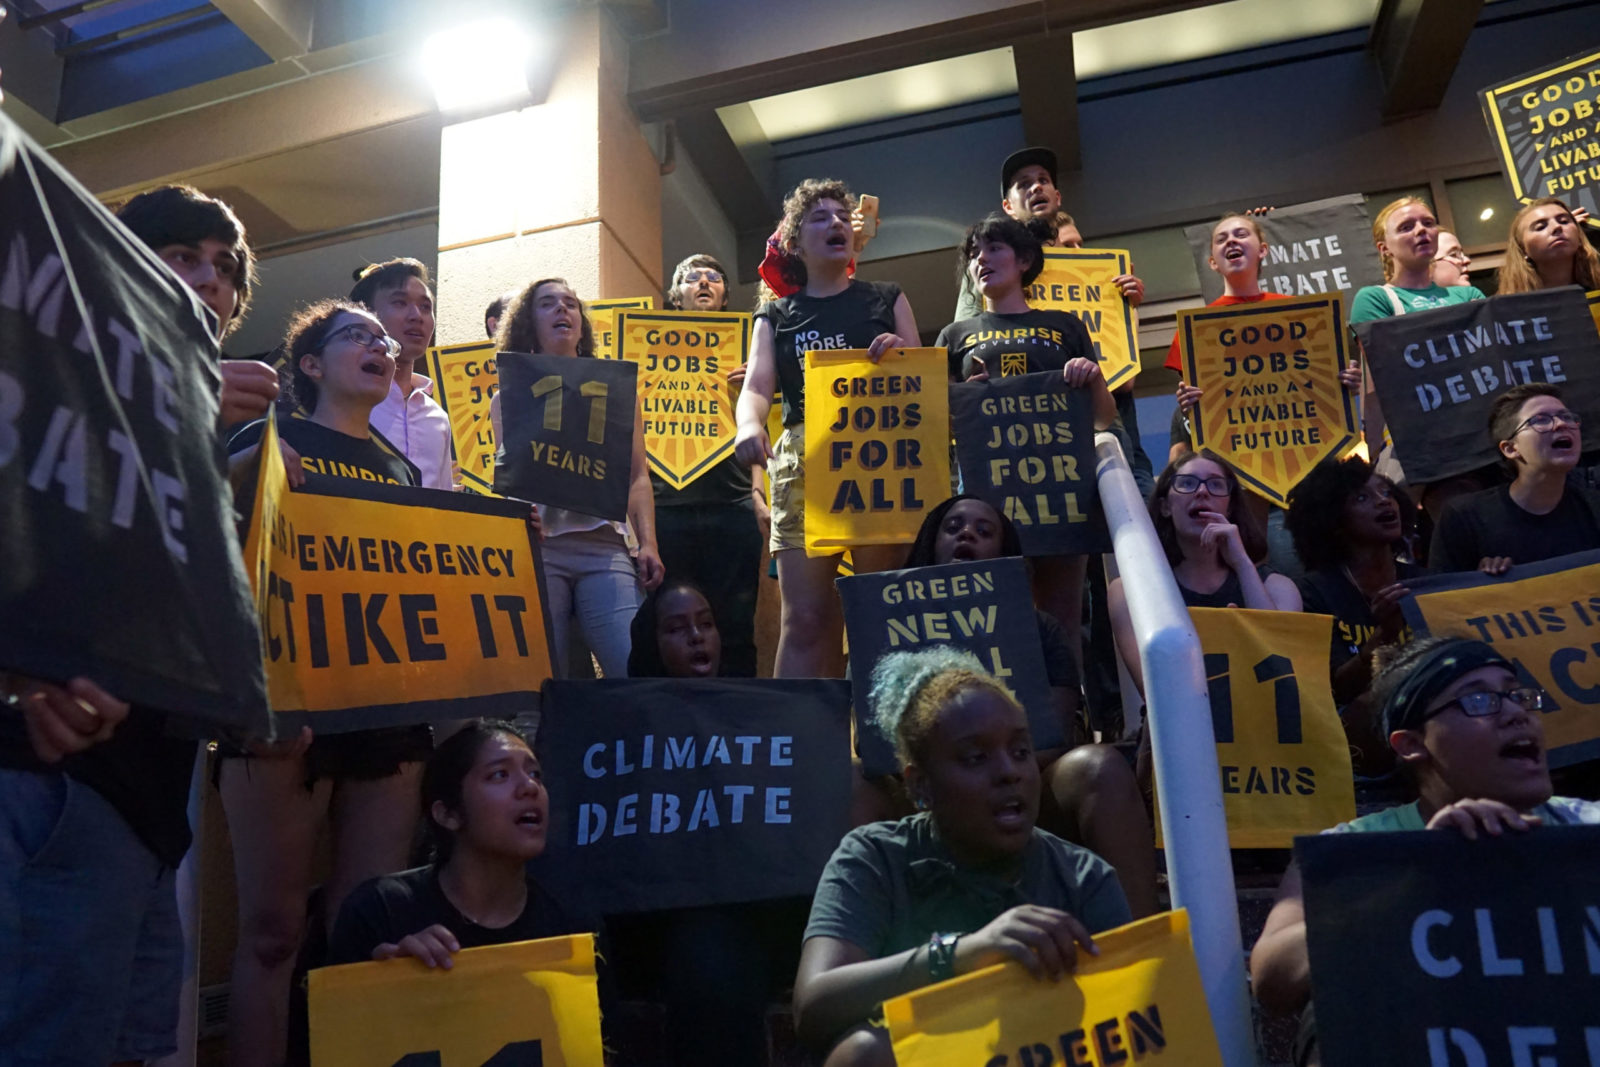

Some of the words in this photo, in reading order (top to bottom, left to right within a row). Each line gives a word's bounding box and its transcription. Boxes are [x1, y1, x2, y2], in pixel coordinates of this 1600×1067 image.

[1529, 94, 1600, 134] JOB
[1550, 127, 1588, 149] AND
[1261, 234, 1343, 267] MATE
[1030, 283, 1102, 302] REEN
[1257, 266, 1353, 295] EBATE
[645, 329, 720, 348] GOOD
[794, 330, 820, 345] NO
[795, 333, 847, 358] MORE
[964, 327, 1064, 348] SUNRISE
[1219, 321, 1307, 347] GOOD
[1403, 316, 1553, 368] CLIMATE
[464, 358, 498, 378] GO
[646, 354, 719, 374] JOBS
[1223, 349, 1310, 378] JOBS
[656, 380, 690, 392] AND
[696, 380, 707, 392] A
[831, 375, 922, 398] GREEN
[1240, 381, 1279, 397] AND
[1286, 381, 1299, 393] A
[1415, 355, 1567, 412] DEBATE
[530, 375, 609, 445] 11
[643, 398, 719, 415] LIVABLE
[830, 402, 922, 433] JOBS
[980, 393, 1069, 416] GREEN
[1227, 400, 1318, 425] LIVABLE
[643, 420, 719, 438] FUTURE
[987, 421, 1075, 449] JOBS
[1231, 427, 1321, 452] FUTURE
[529, 440, 608, 481] YEARS
[829, 438, 923, 471] FOR
[990, 454, 1081, 486] FOR
[829, 477, 924, 514] ALL
[1003, 492, 1089, 526] ALL
[297, 534, 516, 578] EMERGENCY
[882, 571, 995, 605] GREEN
[305, 592, 447, 669] IKE
[470, 593, 530, 659] IT
[886, 605, 998, 647] NEW
[1465, 606, 1567, 643] THIS
[582, 734, 793, 779] CLIMATE
[1221, 765, 1317, 796] EARS
[577, 785, 793, 846] DEBATE
[1410, 905, 1600, 979] CLI
[985, 1003, 1168, 1067] REEN
[1426, 1025, 1600, 1067] DE
